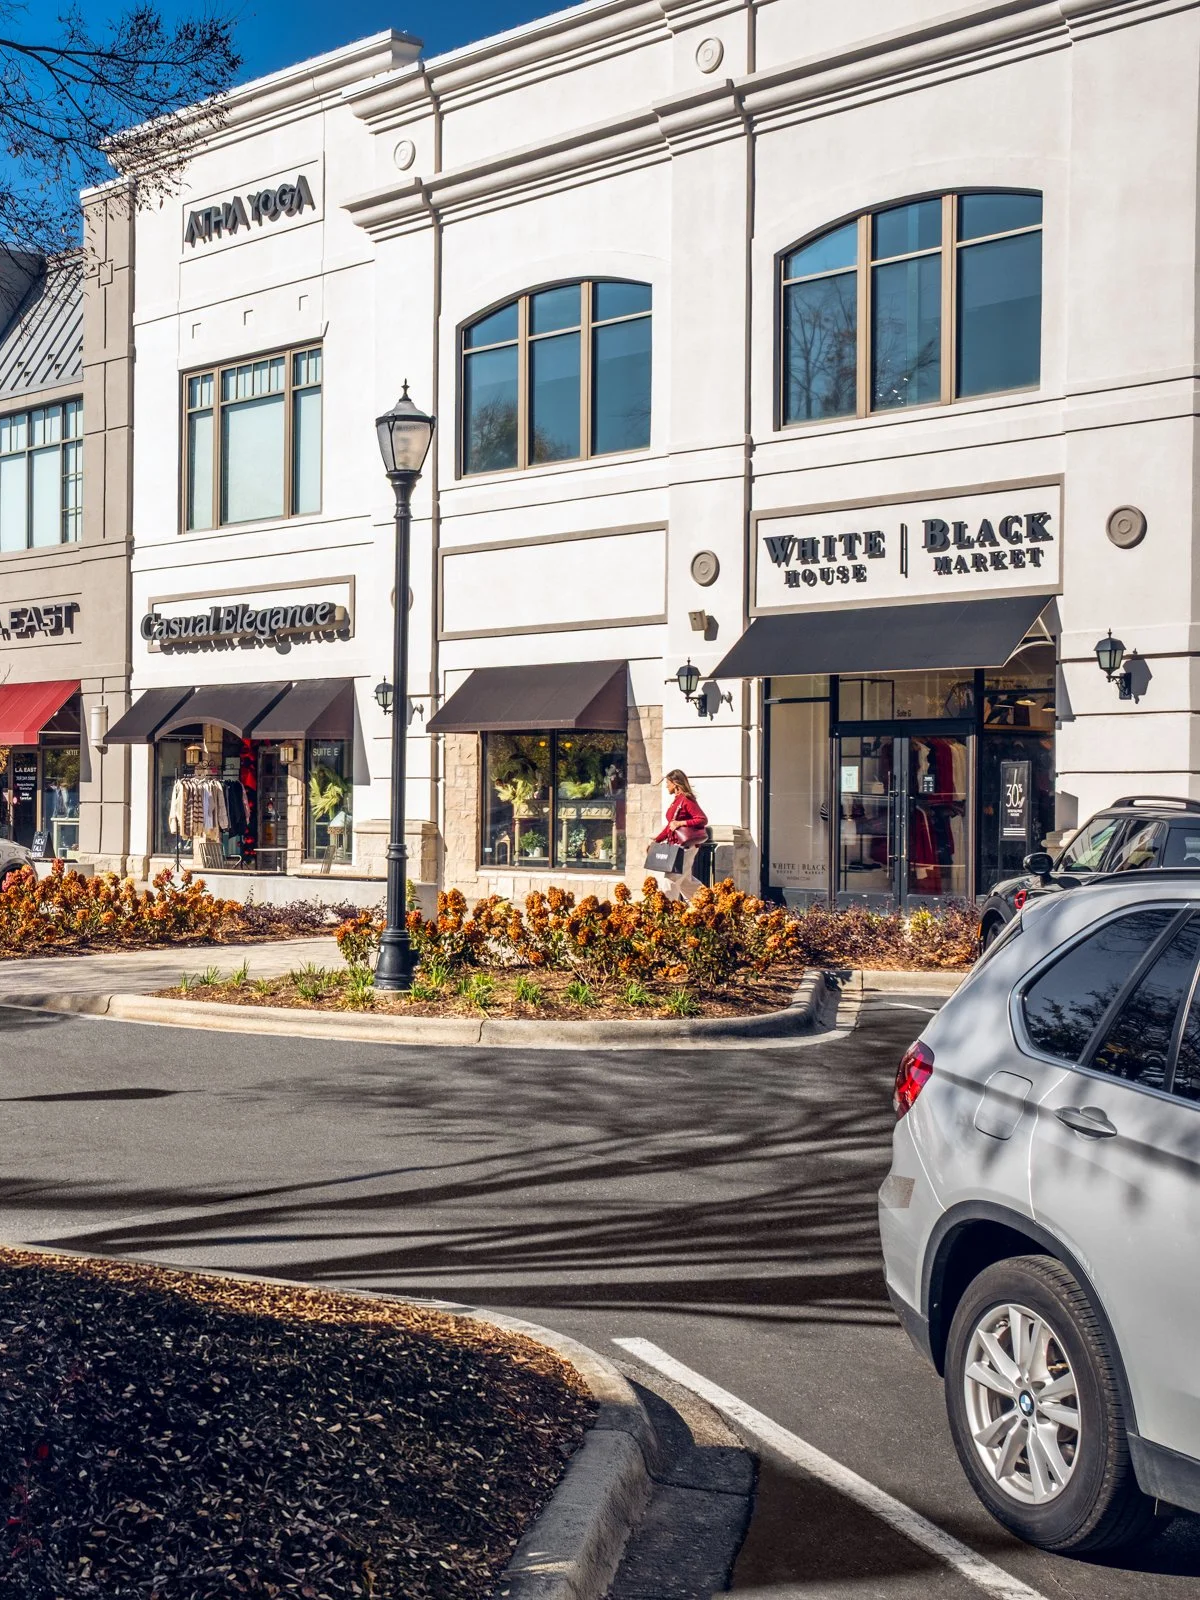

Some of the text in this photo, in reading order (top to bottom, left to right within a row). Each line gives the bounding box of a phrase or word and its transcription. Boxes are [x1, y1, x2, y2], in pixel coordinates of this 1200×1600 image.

[185, 175, 316, 247] ATHA YOGA
[763, 512, 1054, 568] WHITE BLACK
[784, 547, 1045, 588] HOUSE MARKET
[8, 602, 77, 636] EAST
[140, 602, 336, 640] Casual Elegance
[312, 747, 339, 757] SUITE E
